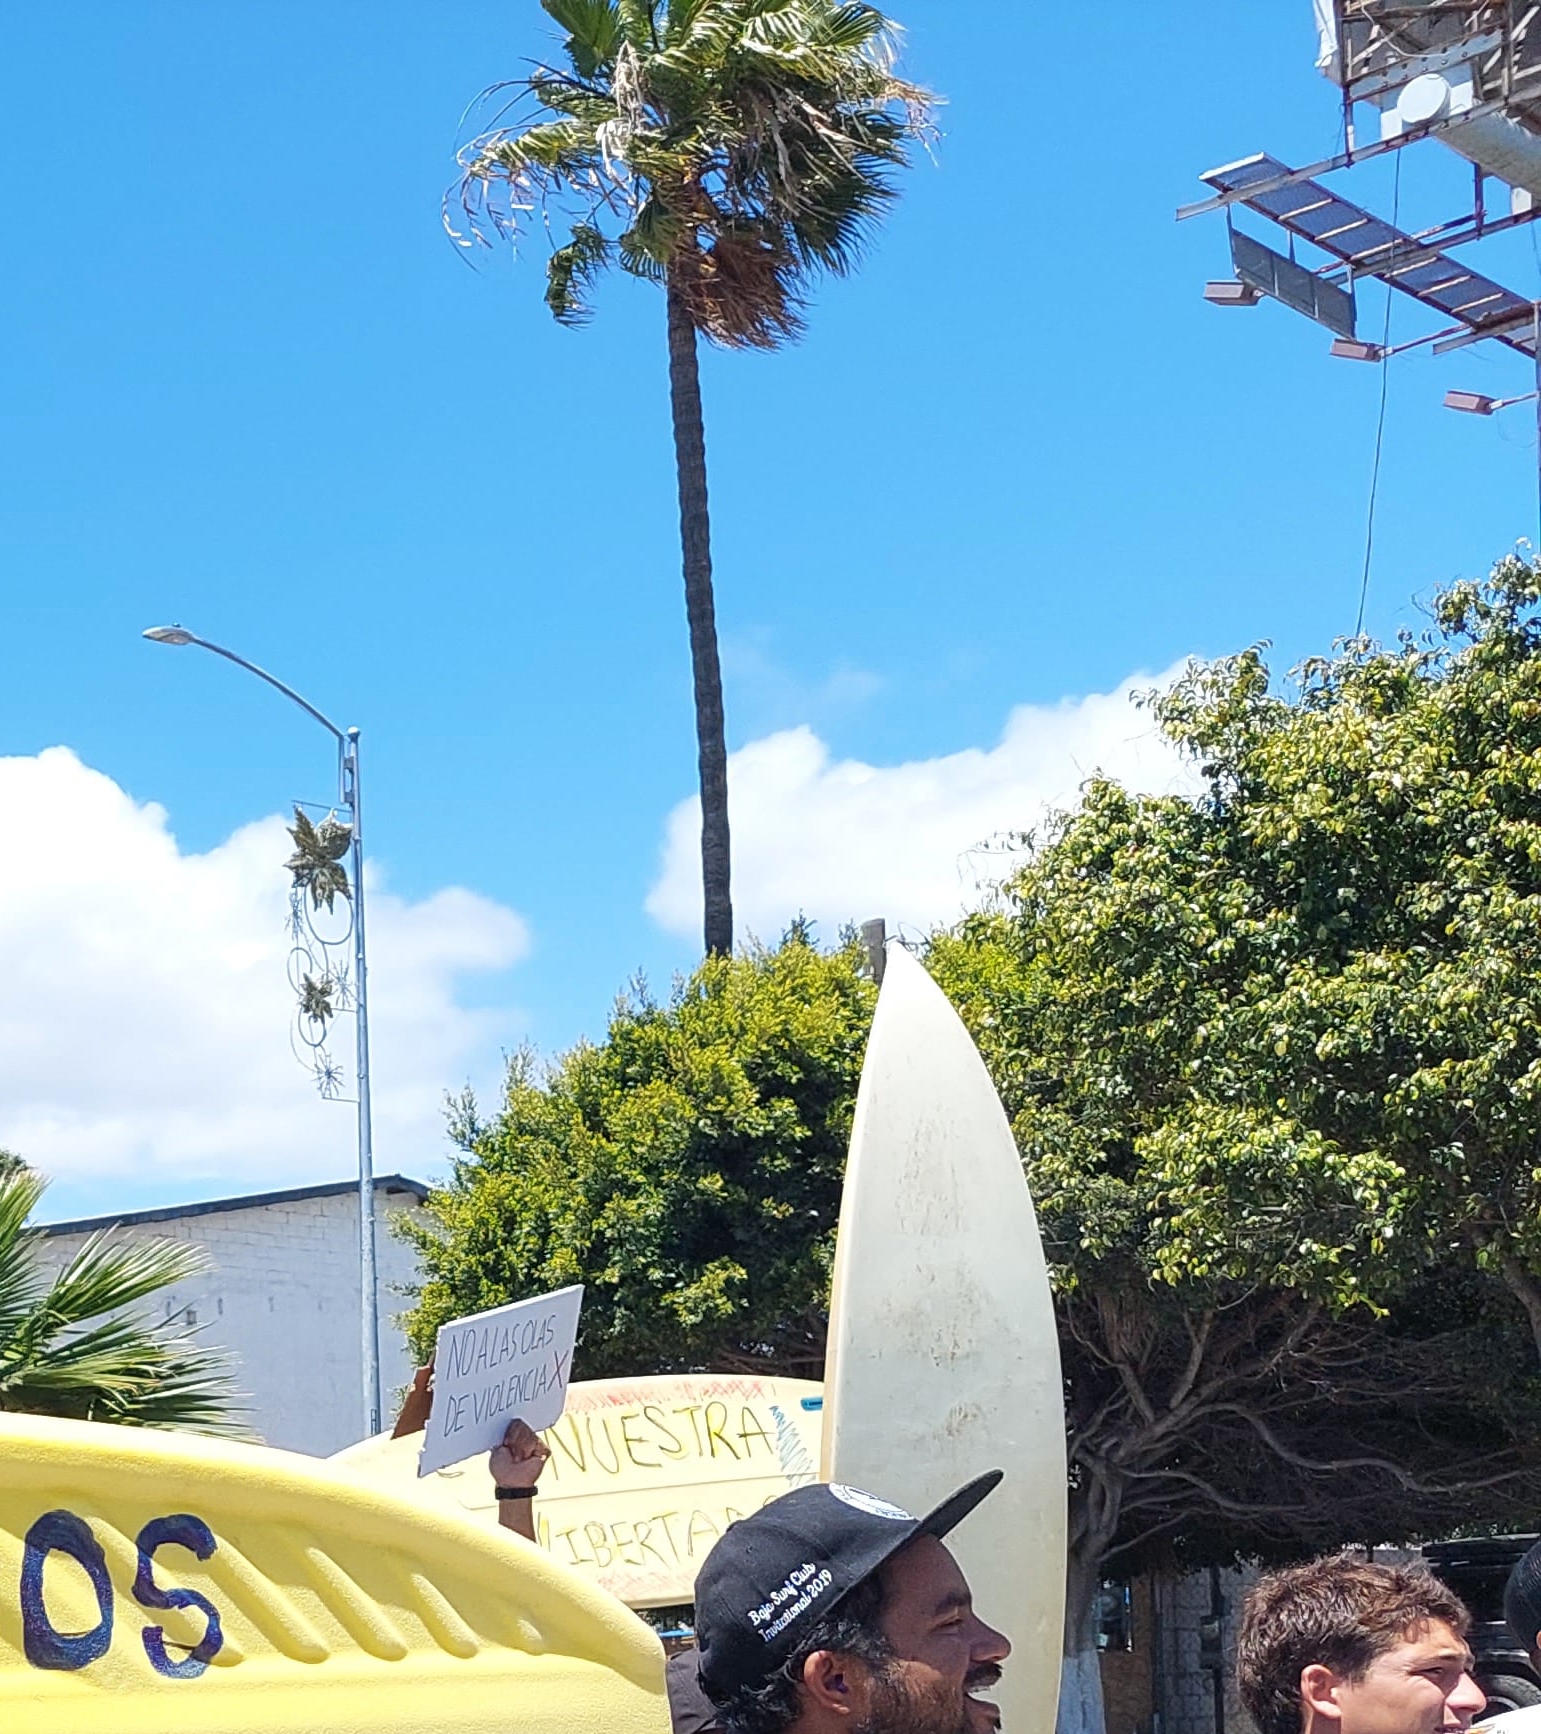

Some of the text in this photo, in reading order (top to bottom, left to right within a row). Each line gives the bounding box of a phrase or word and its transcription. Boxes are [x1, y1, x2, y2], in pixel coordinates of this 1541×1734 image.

[447, 1328, 476, 1381] NO
[522, 1314, 557, 1355] OLAS
[444, 1394, 469, 1438] DE
[472, 1363, 548, 1425] VIOLENCIA
[544, 1400, 778, 1481] NUESTRA
[748, 1561, 817, 1627] Baja Surf Club
[806, 1568, 833, 1599] 2019
